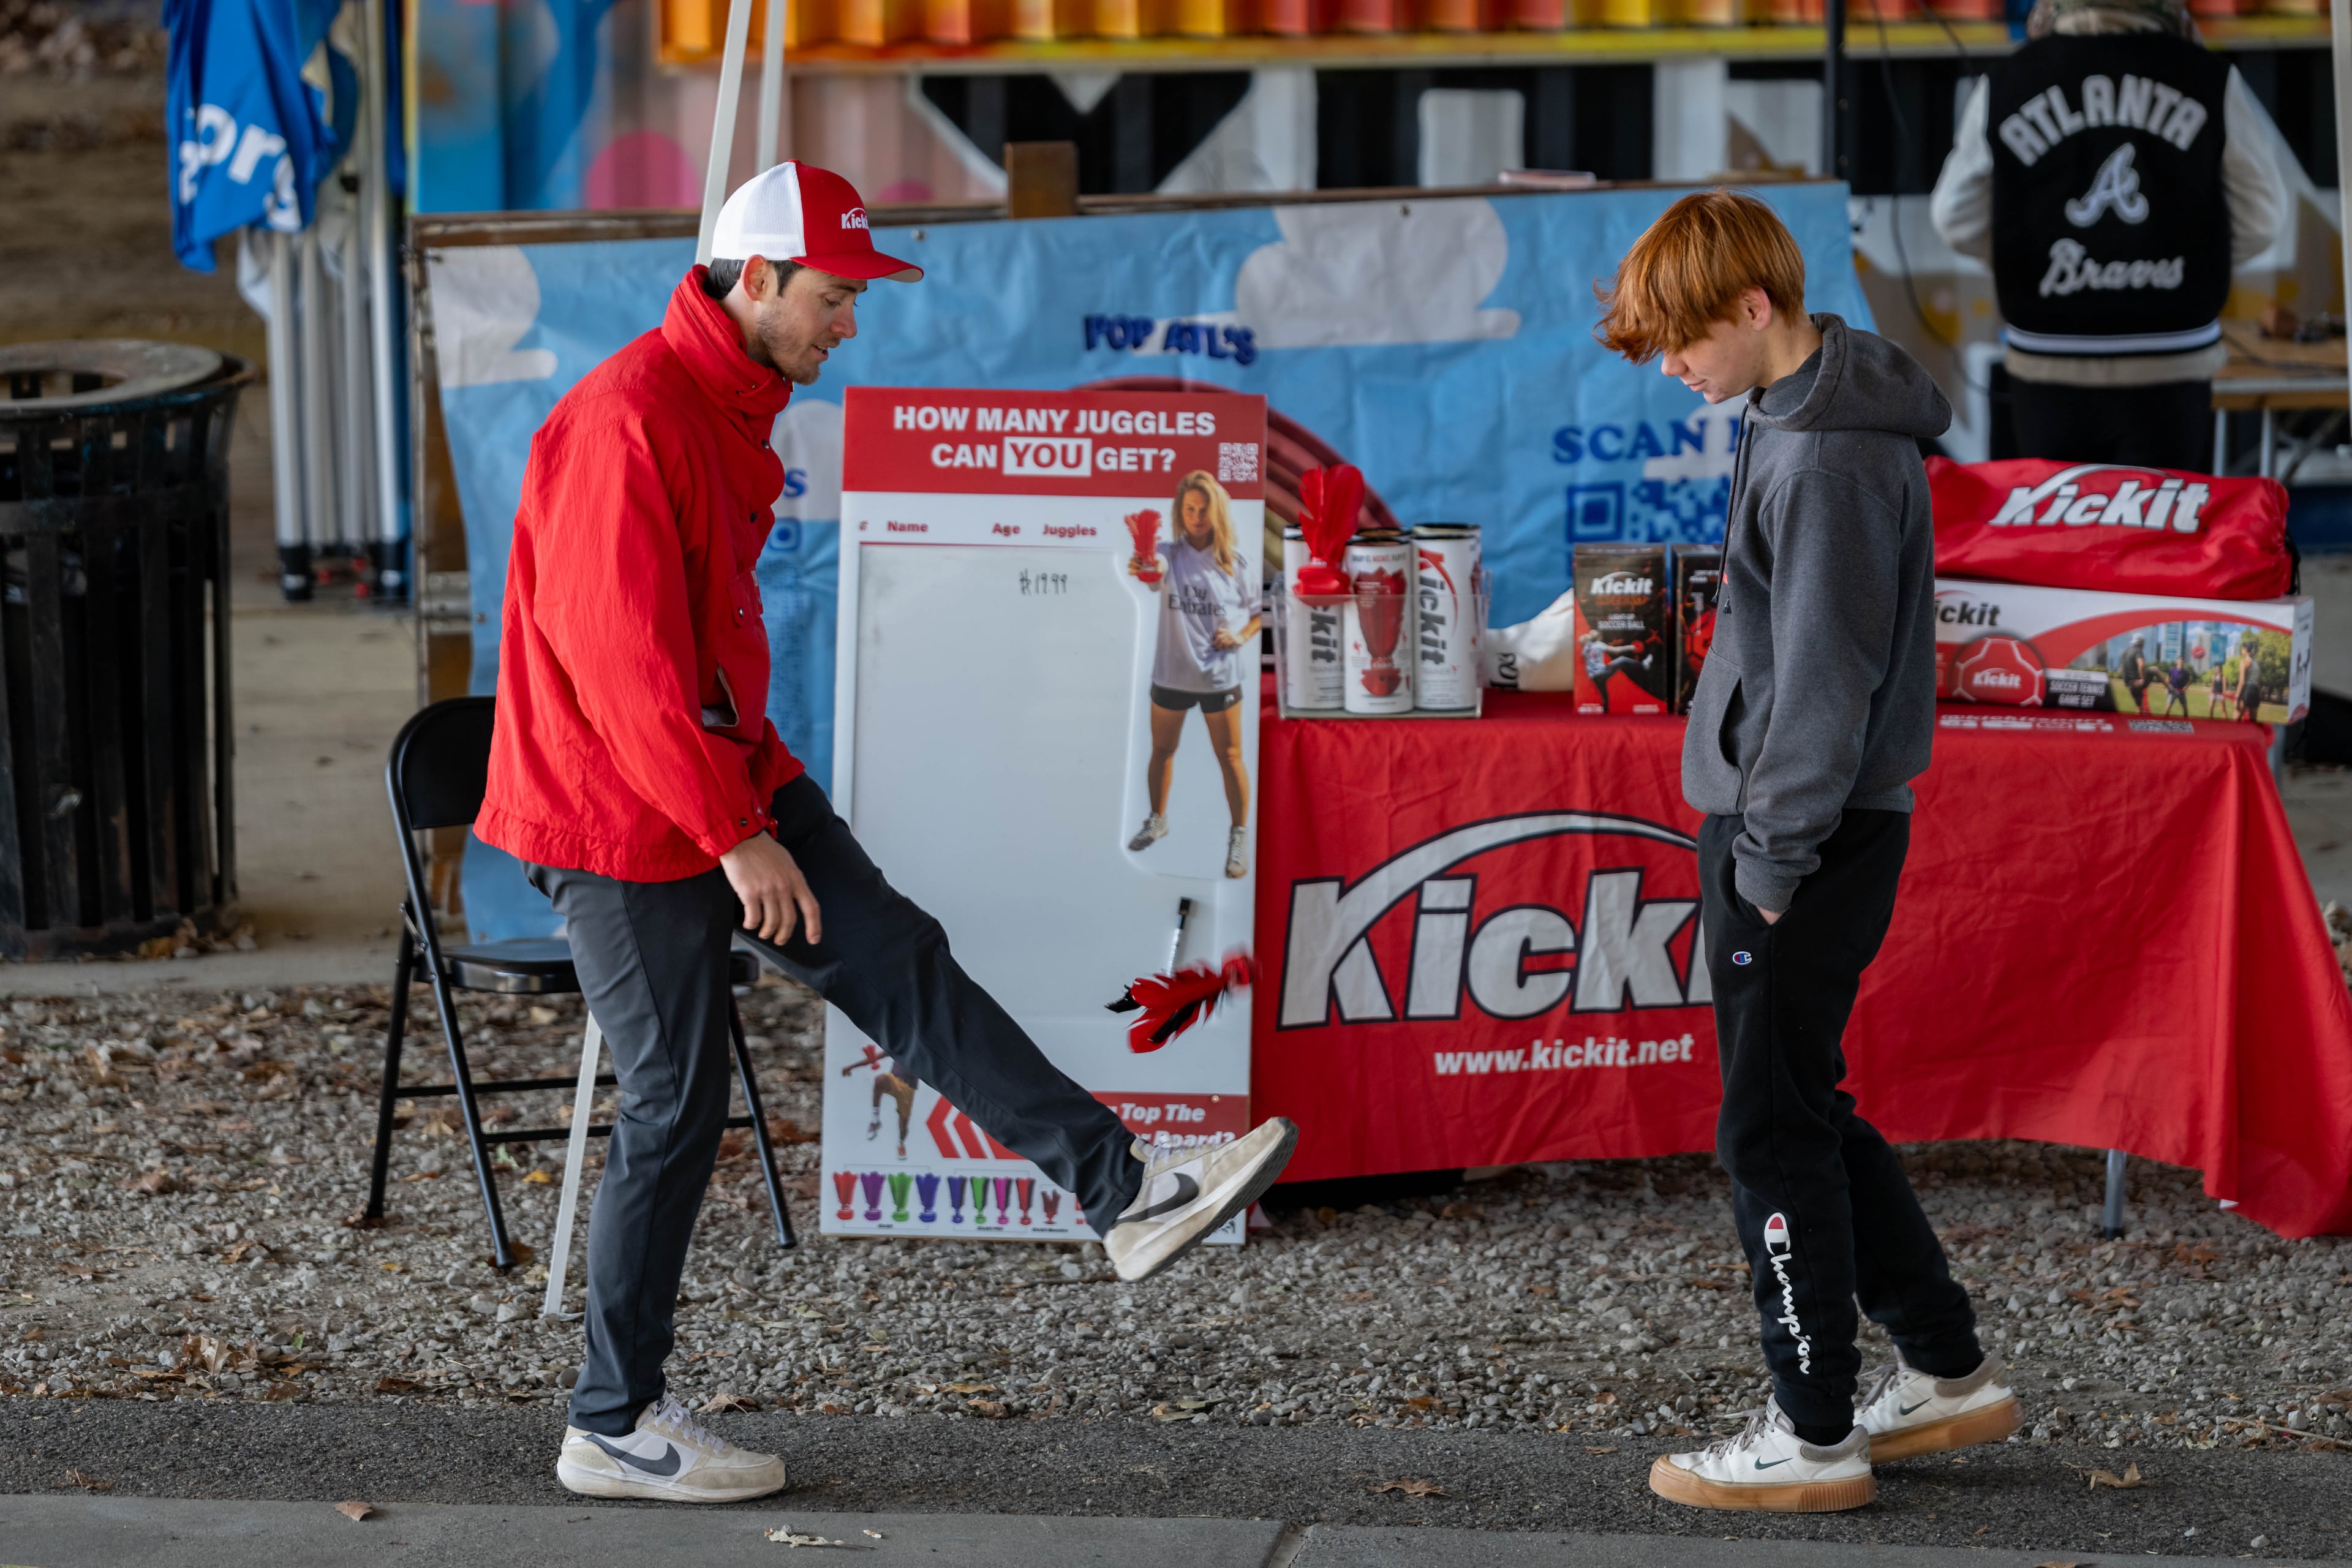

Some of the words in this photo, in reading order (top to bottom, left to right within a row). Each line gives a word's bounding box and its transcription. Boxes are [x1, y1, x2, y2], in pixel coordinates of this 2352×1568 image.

[1999, 74, 2207, 167] ATLANTA
[2039, 238, 2185, 298] Braves
[1083, 314, 1155, 351] POP
[894, 405, 970, 431] HOW
[976, 407, 1069, 433] MANY
[1074, 409, 1216, 436] JUGGLES
[931, 443, 998, 469] CAN
[1008, 443, 1085, 469] YOU
[1096, 447, 1176, 472] GET?
[1552, 418, 1709, 464] SCAN
[1987, 464, 2211, 534] Kickit
[887, 520, 929, 532] Name
[992, 522, 1020, 537] Age
[1042, 522, 1097, 538] Juggles
[1590, 571, 1654, 595] Kickit
[1419, 548, 1458, 665] Kickit
[1934, 600, 2002, 626] ickit
[1972, 668, 2021, 688] Kickit
[1434, 1033, 1694, 1076] www.kickit.net
[1120, 1102, 1162, 1125] Top
[1164, 1103, 1206, 1122] The
[1764, 1212, 1811, 1374] Champion
